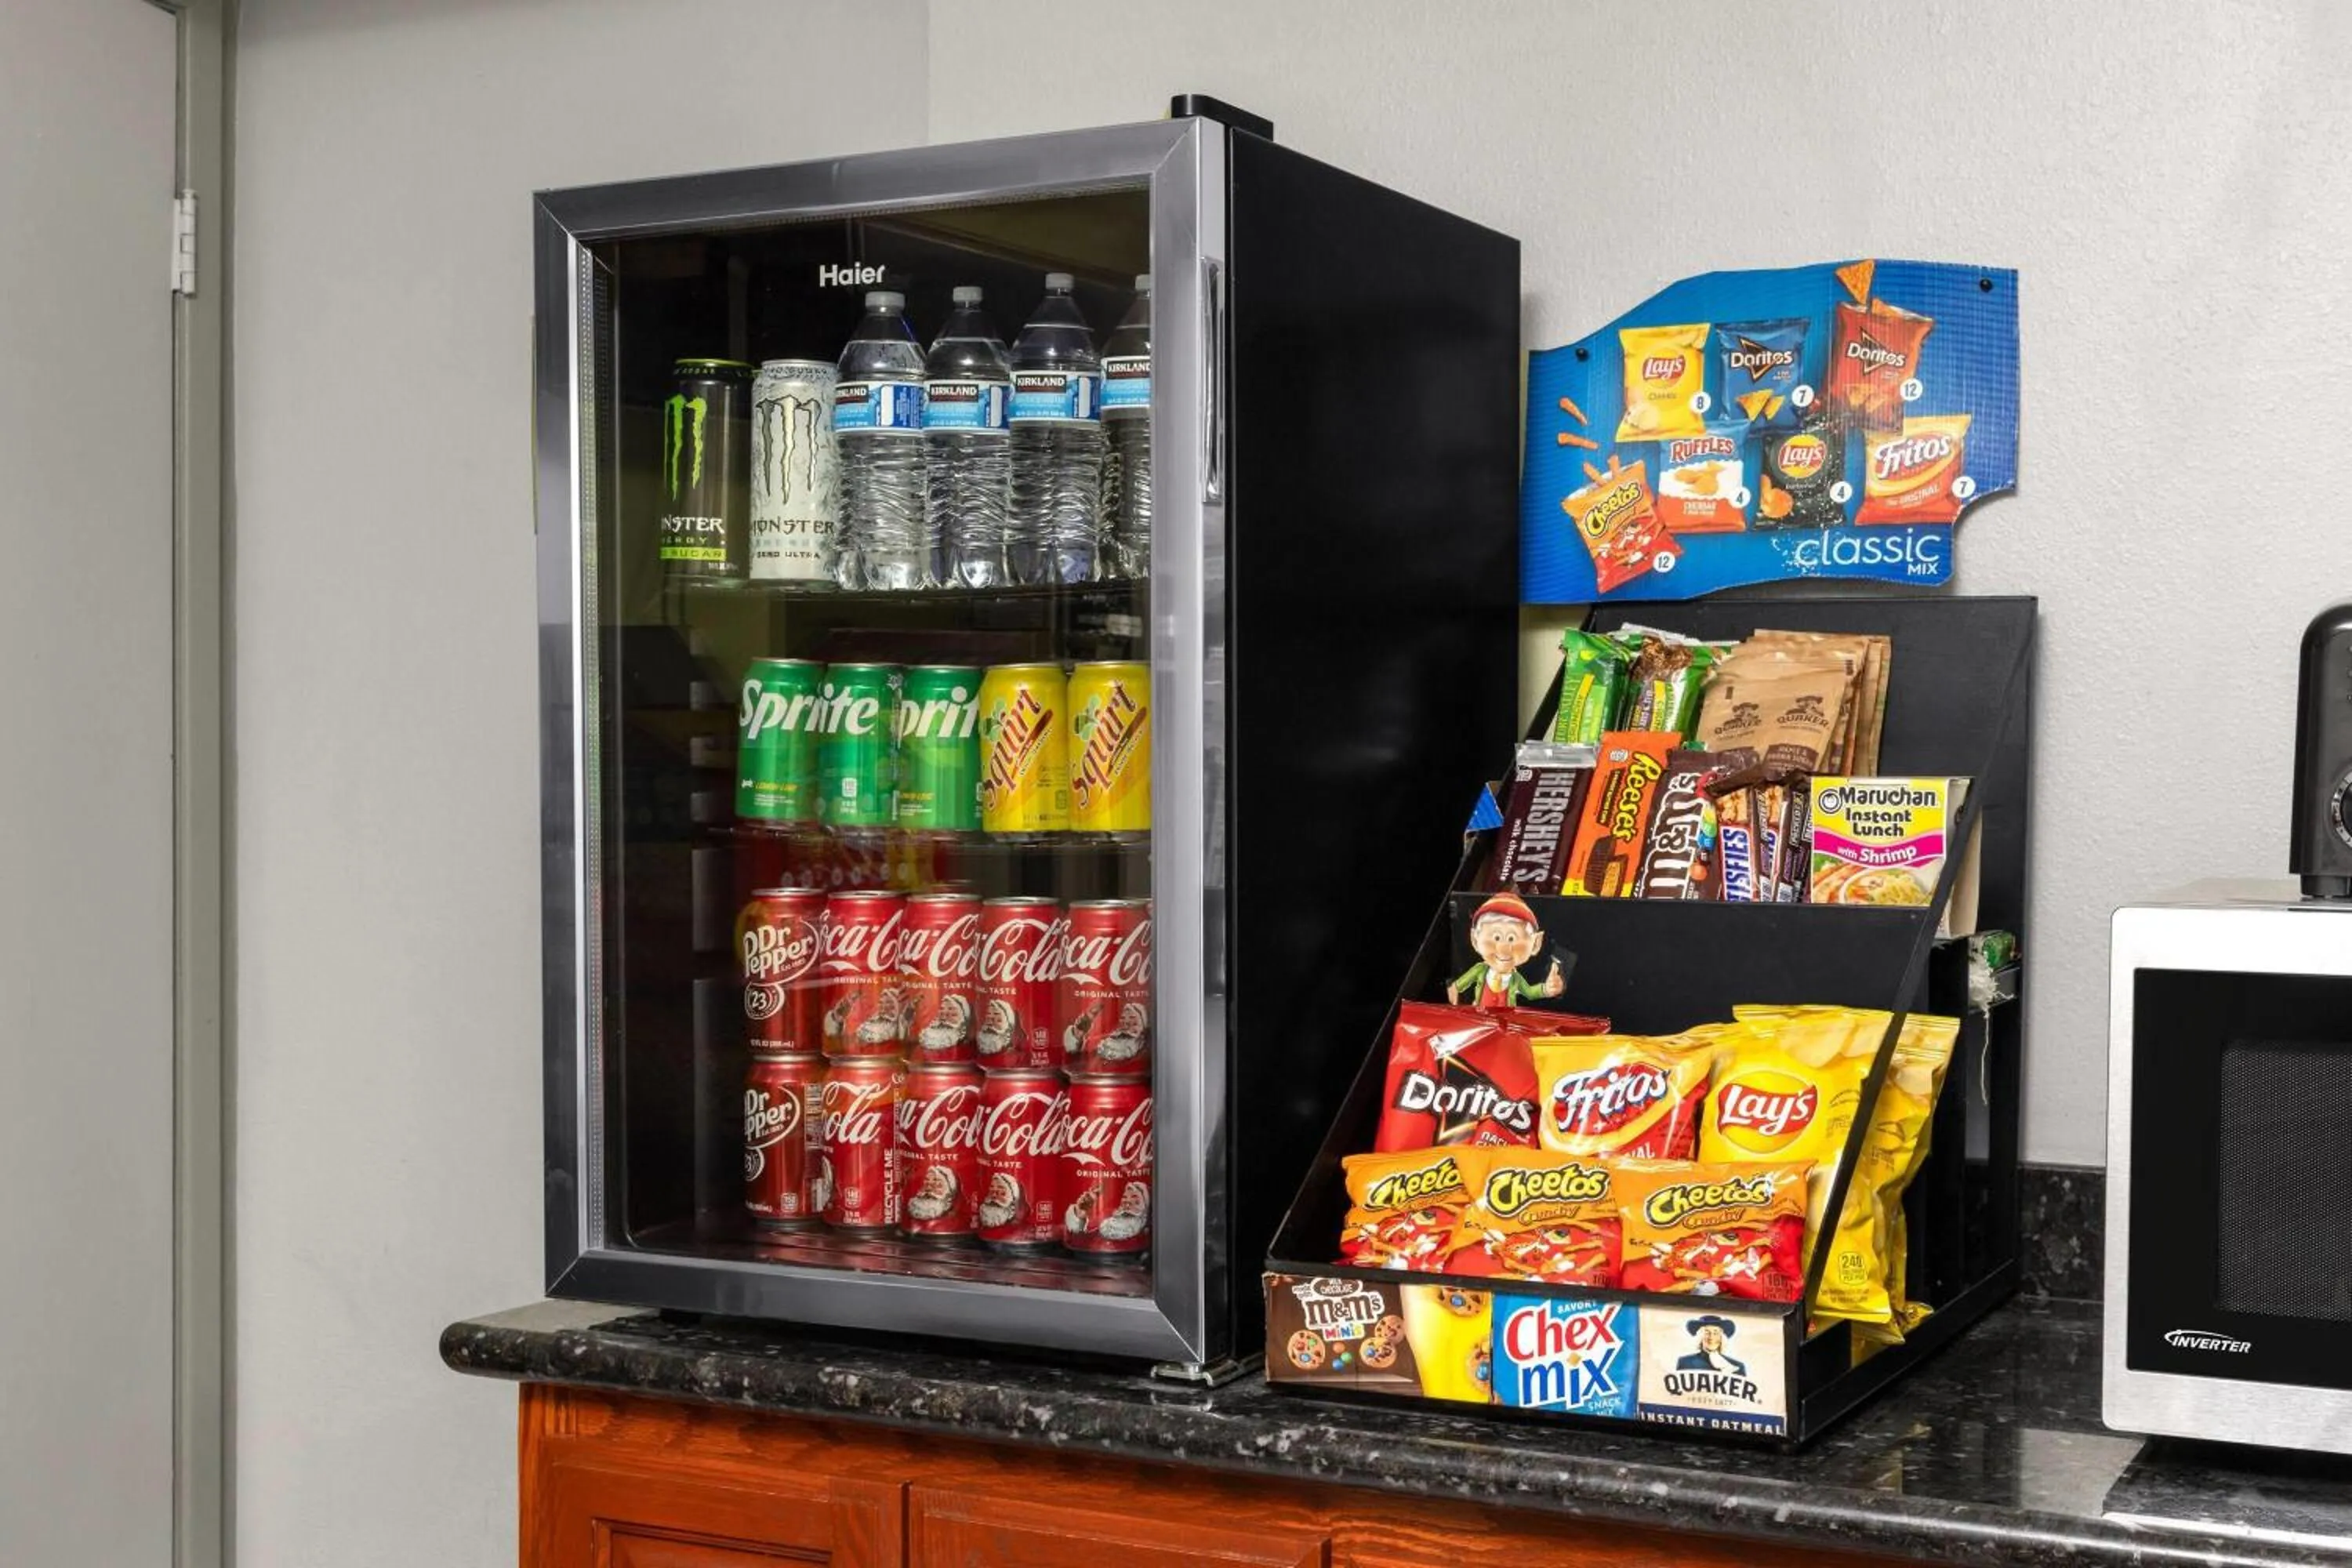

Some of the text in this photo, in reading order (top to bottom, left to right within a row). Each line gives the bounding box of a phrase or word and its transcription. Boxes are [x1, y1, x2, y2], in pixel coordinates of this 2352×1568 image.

[819, 264, 884, 286] Haier
[1731, 350, 1793, 368] Doritos
[1847, 343, 1906, 366] Doritos
[931, 386, 978, 397] KIRKLAND
[1017, 377, 1065, 387] KIRKLAND
[1904, 383, 1918, 397] 12
[1696, 394, 1704, 409] 8
[1798, 390, 1806, 403] 7
[1671, 437, 1735, 463] RUFFLES
[1875, 435, 1952, 479] Fritos
[1735, 488, 1744, 503] 4
[1836, 485, 1846, 499] 4
[1960, 481, 1968, 495] 7
[1584, 481, 1642, 537] Cheetos
[1795, 528, 1941, 565] classic
[1657, 555, 1671, 568] 12
[1907, 563, 1938, 575] MIX
[1777, 714, 1830, 728] QUAKER
[1612, 752, 1663, 844] Reese's
[1840, 786, 1936, 806] Maruchan
[1846, 808, 1912, 824] Instant
[1512, 771, 1575, 883] HERSHEY'S
[1853, 823, 1904, 837] Lunch
[1499, 818, 1523, 881] milk chocolate
[1837, 845, 1918, 864] with Shrimp
[757, 925, 791, 959] Dr
[744, 931, 814, 978] Pepper
[753, 990, 768, 1010] 23
[989, 986, 1017, 995] TASTE
[1074, 989, 1120, 998] ORIGINAL
[1399, 1073, 1534, 1132] Doritos
[1555, 1066, 1668, 1131] Fritos
[1722, 1084, 1817, 1138] Lay's
[993, 1160, 1022, 1169] TASTE
[1076, 1169, 1123, 1178] ORIGINAL
[884, 1149, 893, 1224] RECYCLE ME
[1487, 1164, 1609, 1217] Cheetos
[1646, 1177, 1772, 1228] Cheetos
[1506, 1305, 1617, 1361] Chex
[2172, 1335, 2252, 1354] INVERTER
[1522, 1347, 1615, 1406] mix
[1663, 1372, 1759, 1405] QUAKER
[1588, 1398, 1621, 1411] SNACK
[1641, 1411, 1785, 1436] INSTANT OATMEAL
